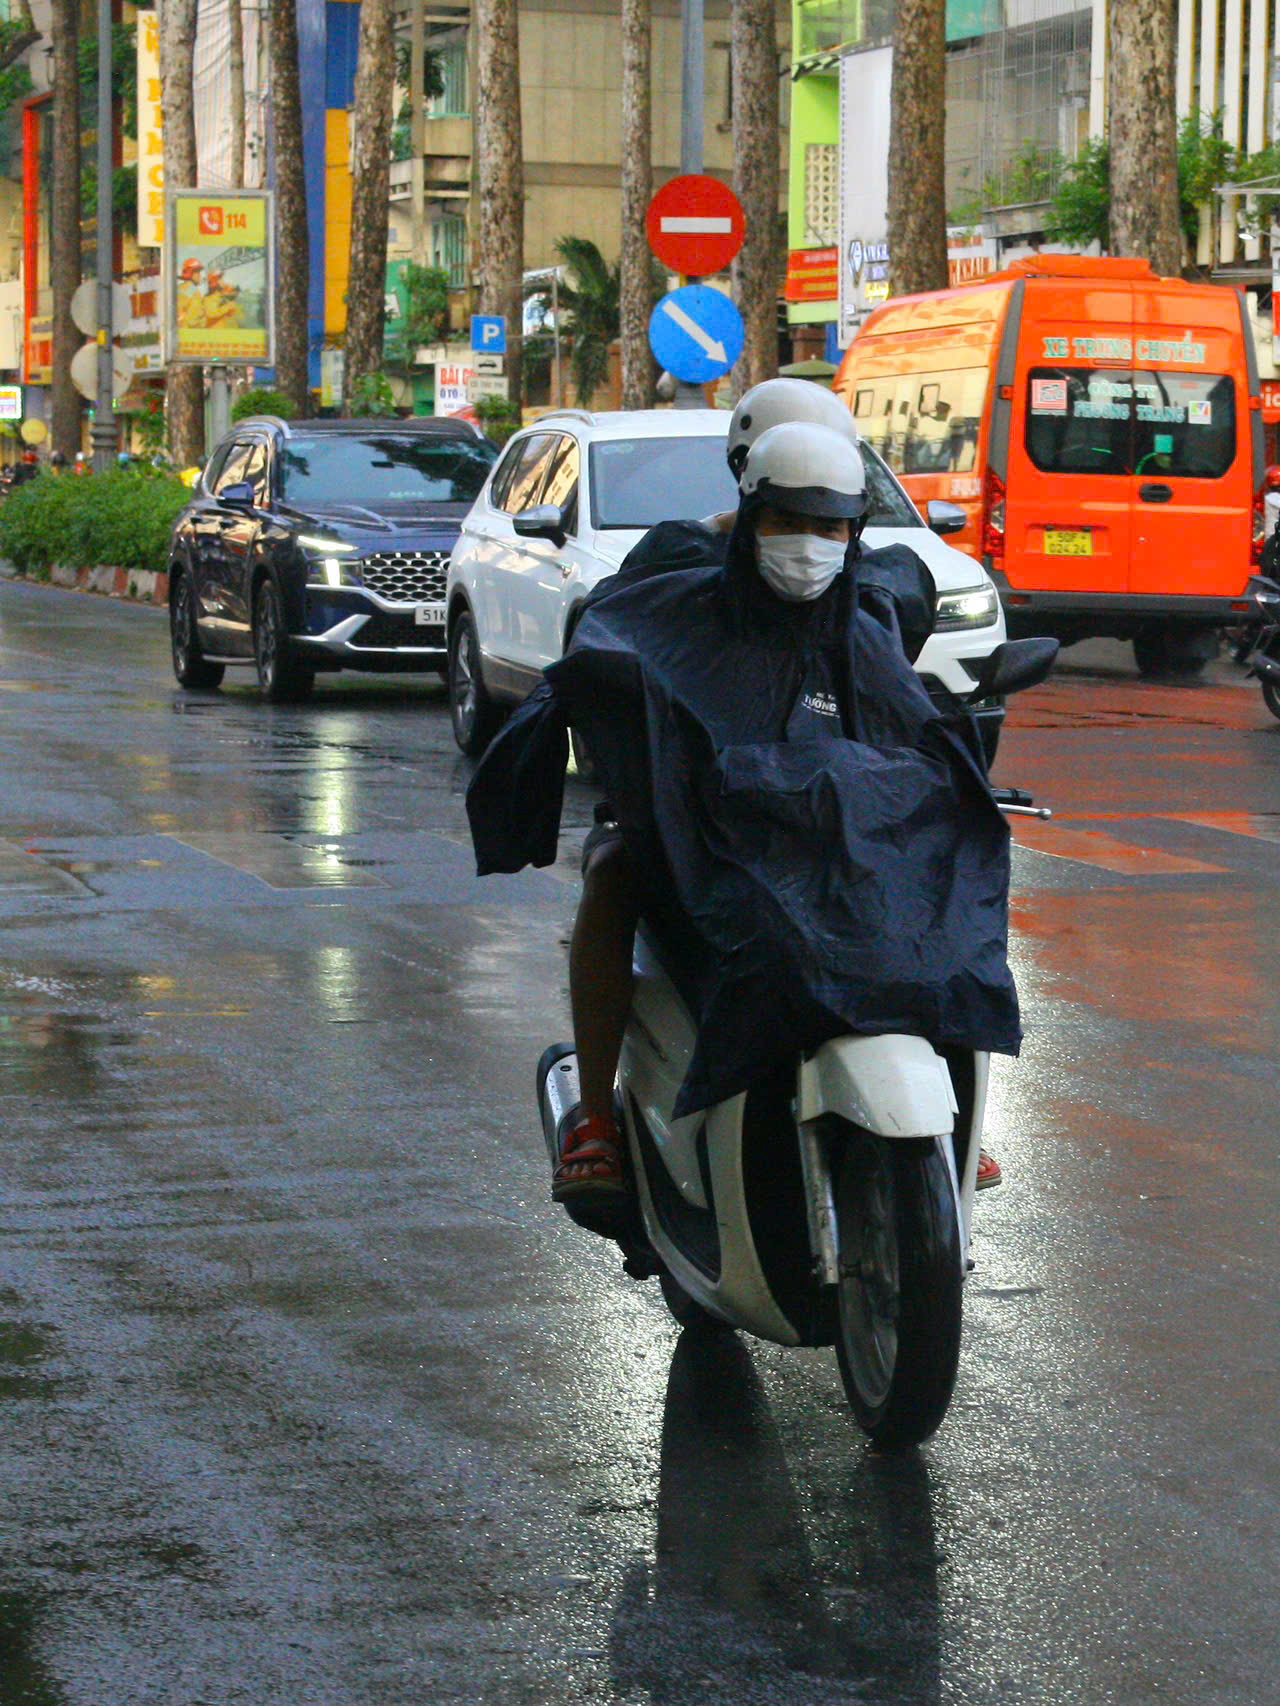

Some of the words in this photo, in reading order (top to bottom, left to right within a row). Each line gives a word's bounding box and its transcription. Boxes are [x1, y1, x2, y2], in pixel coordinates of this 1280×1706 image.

[227, 213, 247, 229] 114
[482, 323, 501, 344] P
[1043, 337, 1070, 359] XE
[1074, 337, 1133, 360] TRUNG
[1137, 330, 1206, 364] CHUYỂN
[1088, 380, 1133, 399] CÔNG
[1135, 384, 1159, 399] TY
[1073, 401, 1130, 420] PHƯƠNG
[1136, 404, 1185, 423] TRANG
[423, 609, 446, 621] 51K
